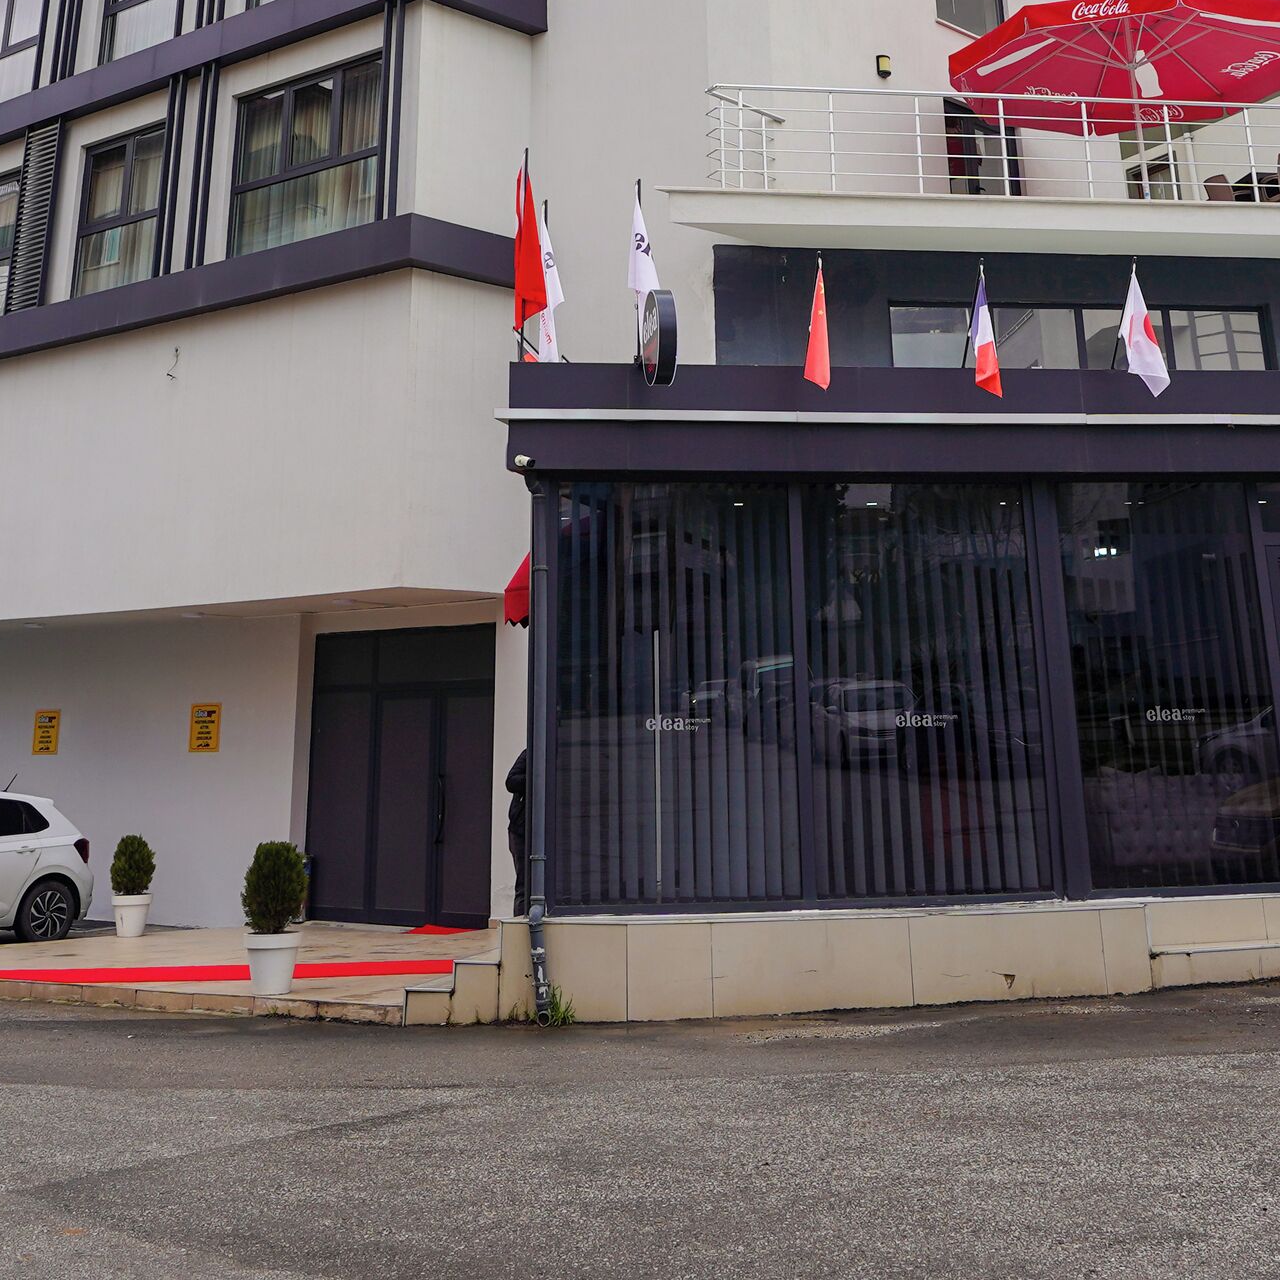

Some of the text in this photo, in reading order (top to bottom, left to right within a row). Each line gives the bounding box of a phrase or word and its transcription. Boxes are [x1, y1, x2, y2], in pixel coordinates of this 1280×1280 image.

[895, 711, 933, 727] elea
[1146, 705, 1183, 721] elea
[646, 714, 684, 731] elea
